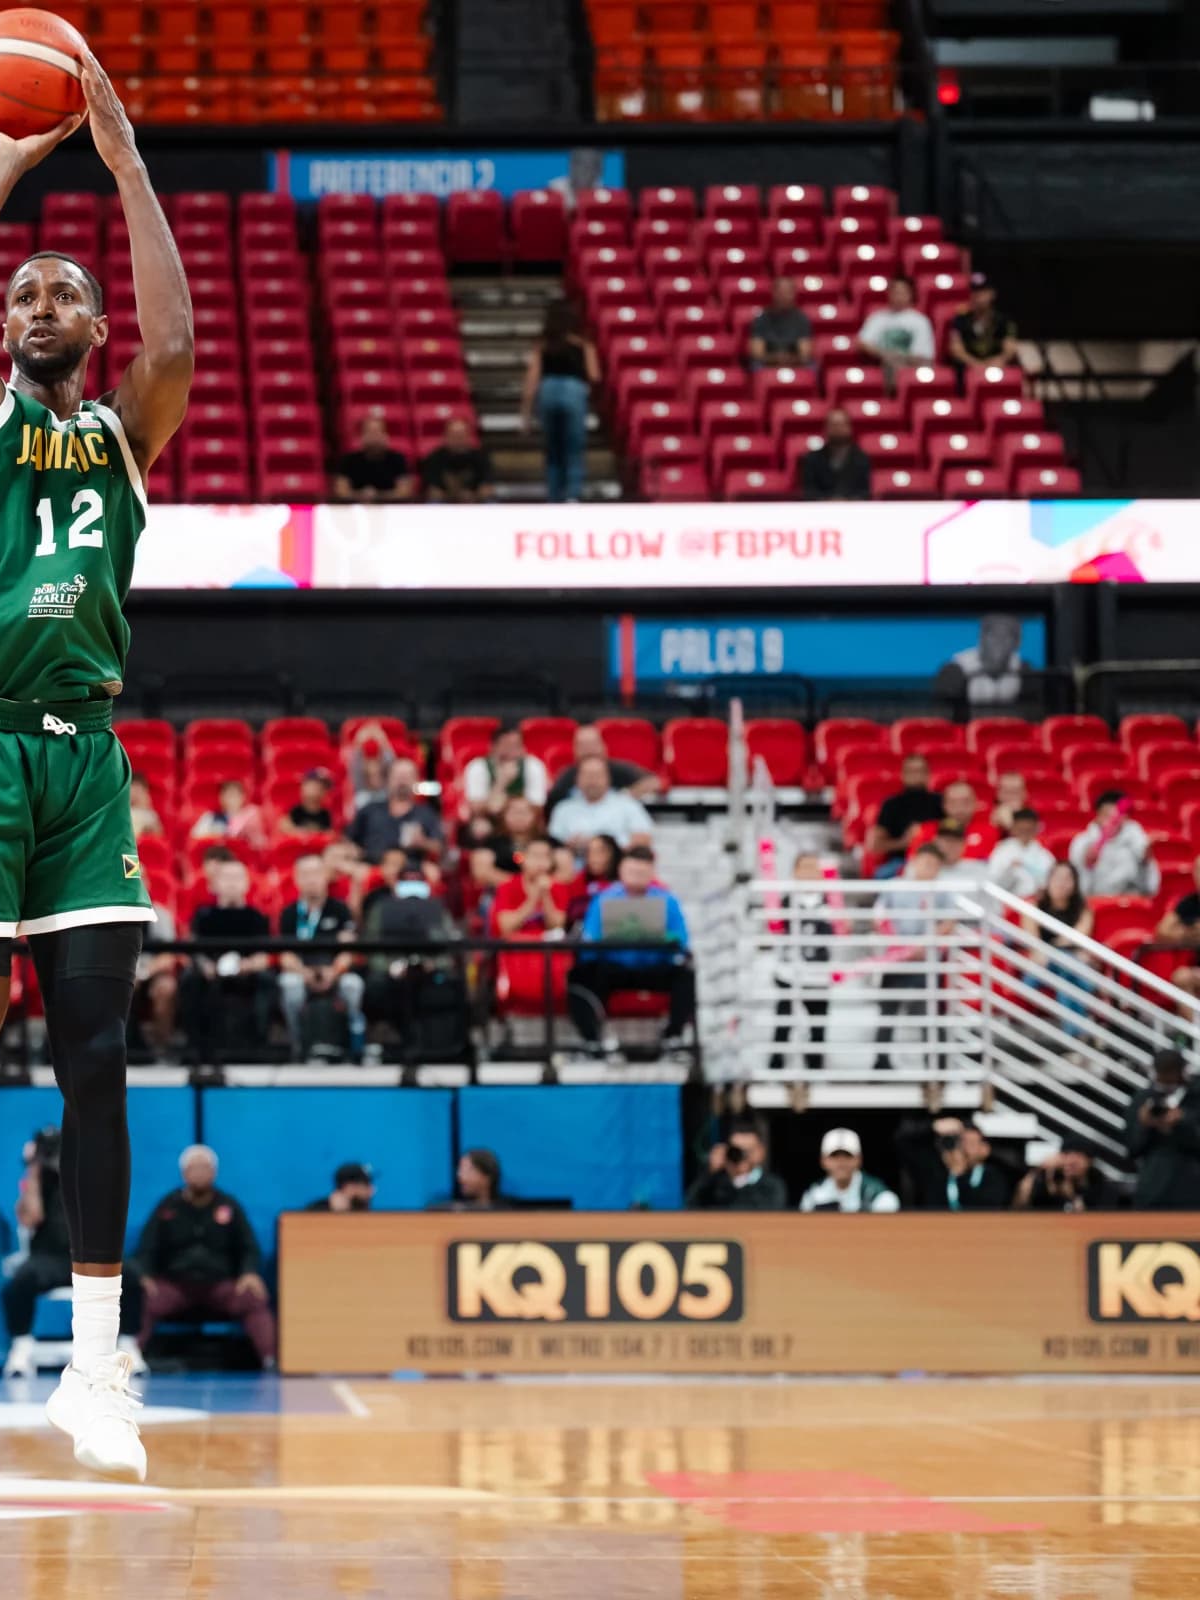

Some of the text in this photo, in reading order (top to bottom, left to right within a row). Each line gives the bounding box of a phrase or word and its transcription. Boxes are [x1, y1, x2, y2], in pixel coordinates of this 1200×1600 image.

[16, 423, 110, 473] JAMAIC
[35, 488, 104, 557] 12
[513, 529, 664, 560] FOLLOW
[29, 593, 81, 605] MARLEY
[457, 1241, 734, 1320] KQ 105
[1098, 1241, 1200, 1320] KQ
